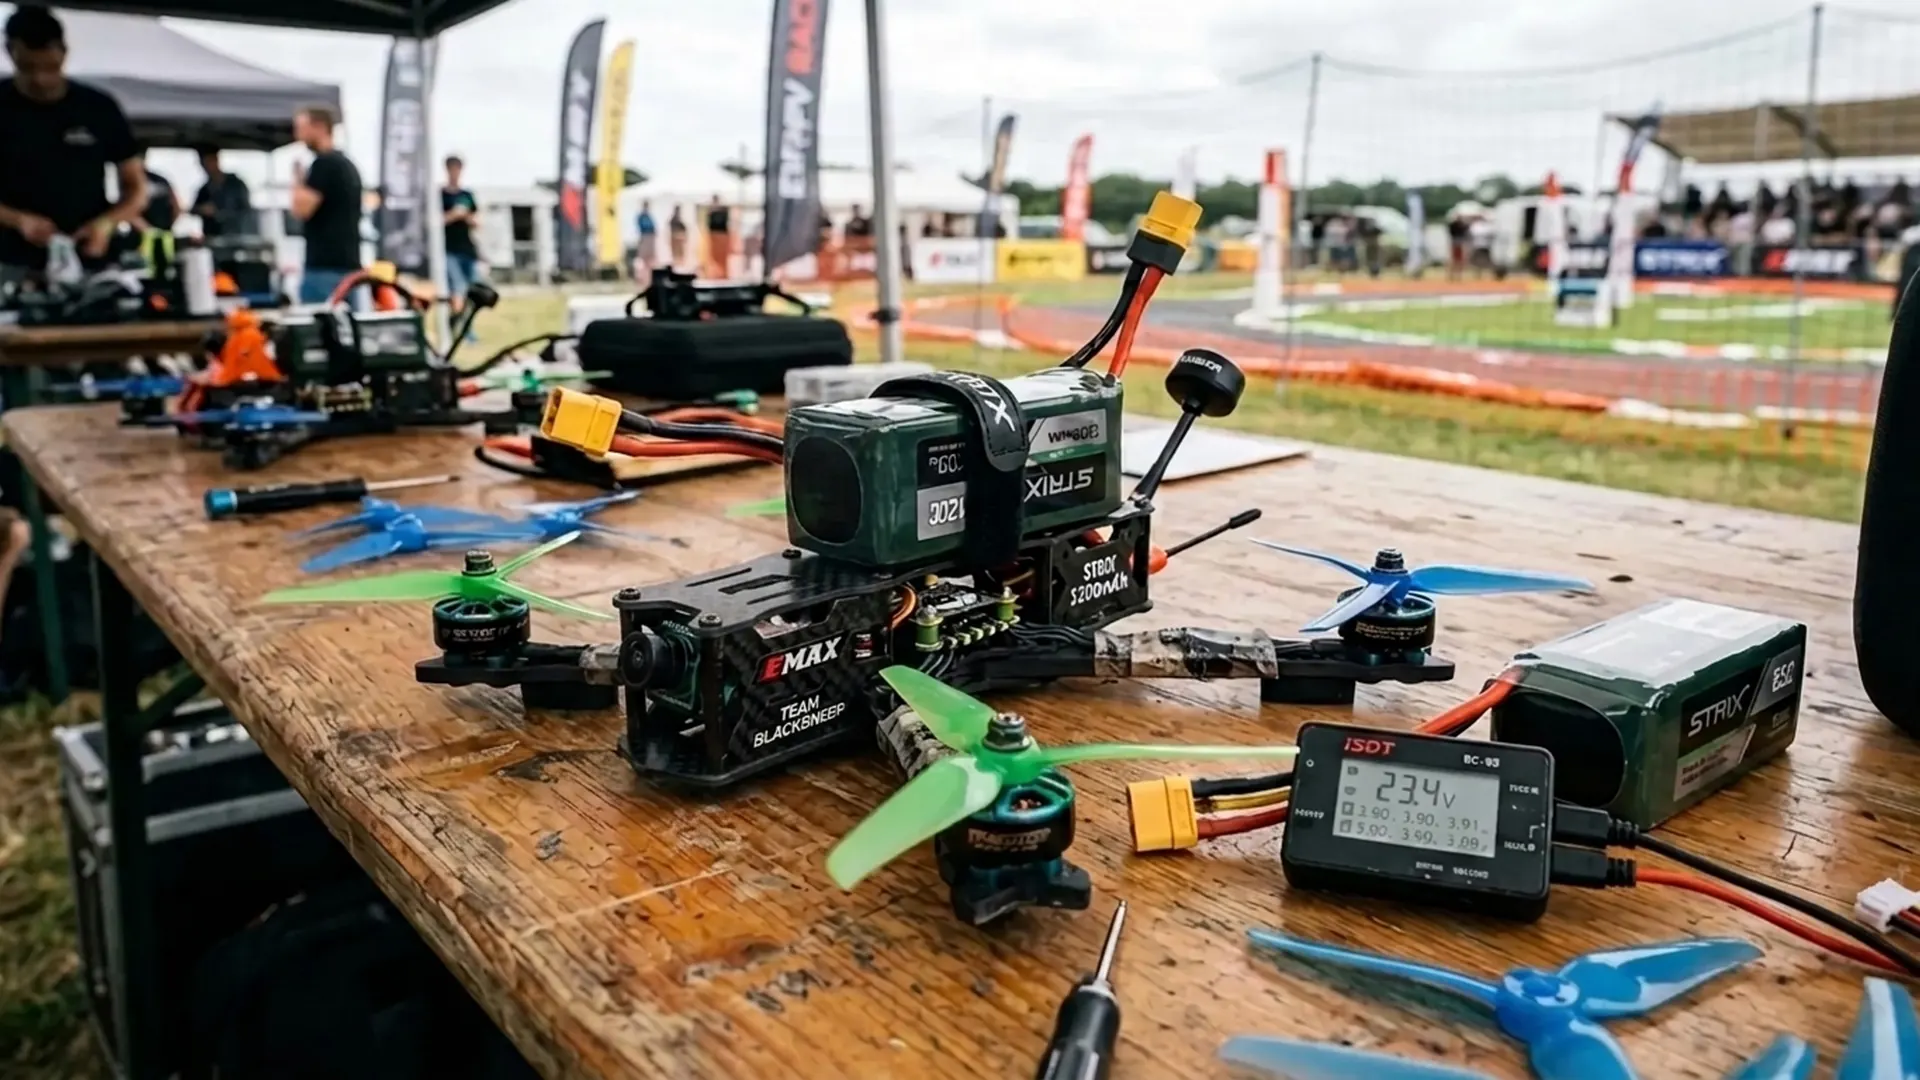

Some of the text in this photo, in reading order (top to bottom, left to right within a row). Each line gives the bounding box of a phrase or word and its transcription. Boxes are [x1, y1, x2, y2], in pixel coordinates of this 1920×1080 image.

[764, 636, 842, 680] EMAX
[780, 694, 820, 721] TEAM
[1687, 684, 1751, 737] STRIX
